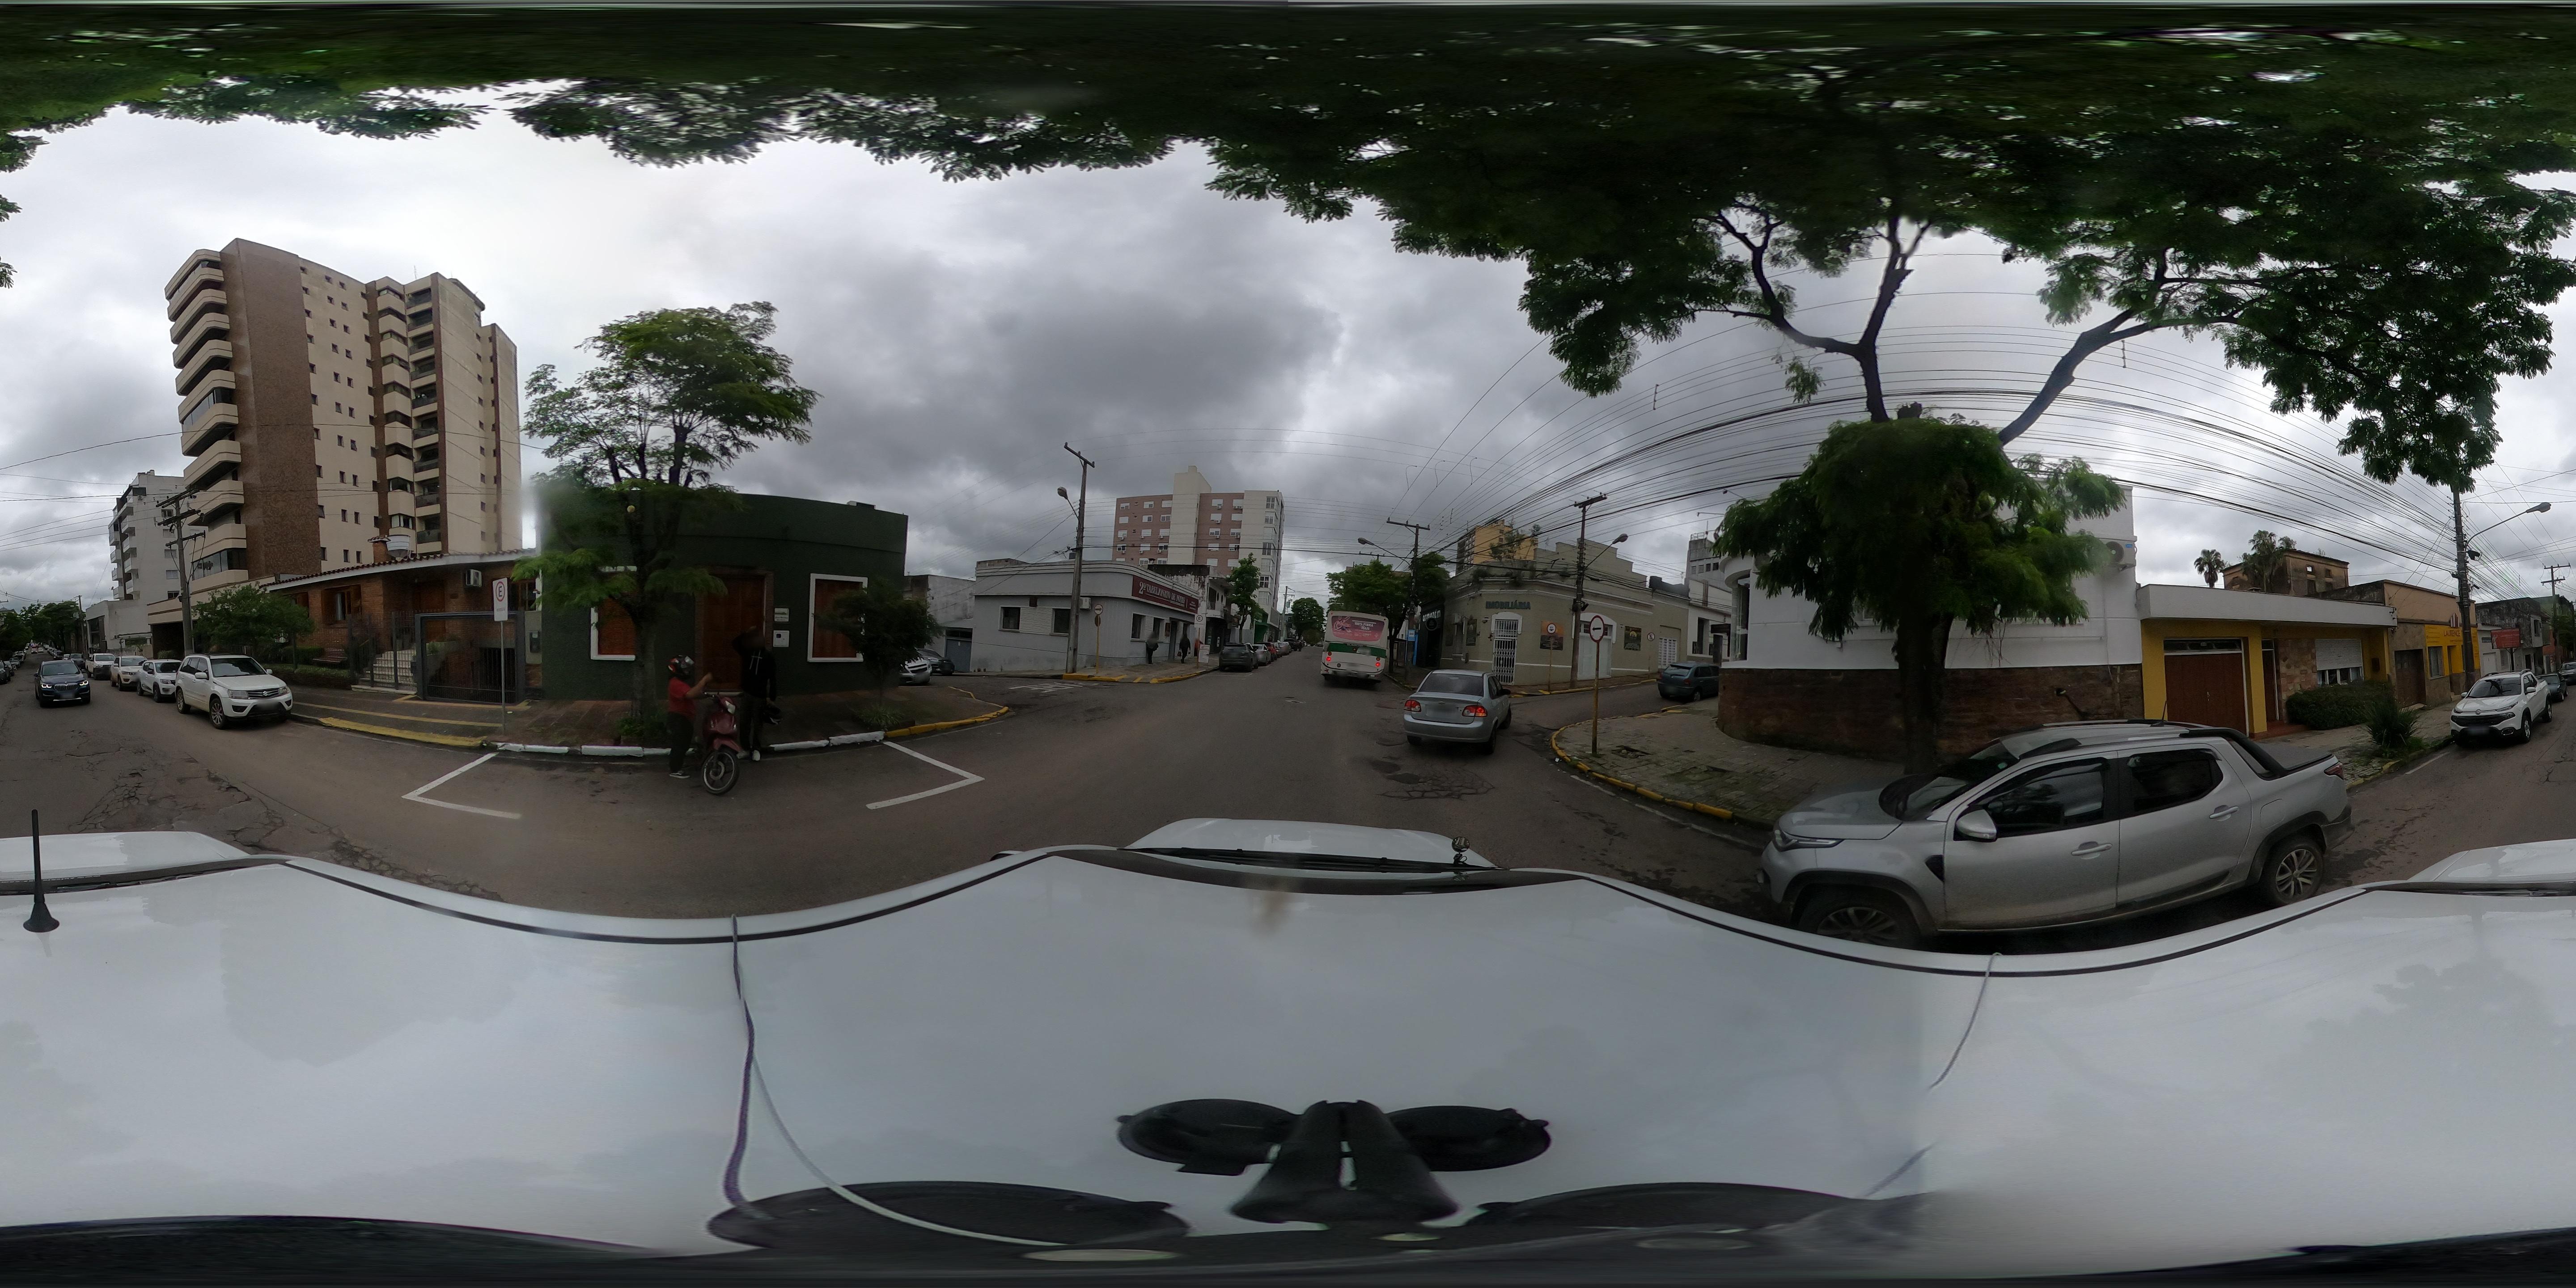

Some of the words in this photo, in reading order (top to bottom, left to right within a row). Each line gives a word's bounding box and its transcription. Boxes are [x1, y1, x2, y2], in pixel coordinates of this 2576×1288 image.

[498, 586, 502, 597] E
[1146, 584, 1171, 598] TABELIONATO
[1485, 600, 1531, 610] IMOBILIÁRIA
